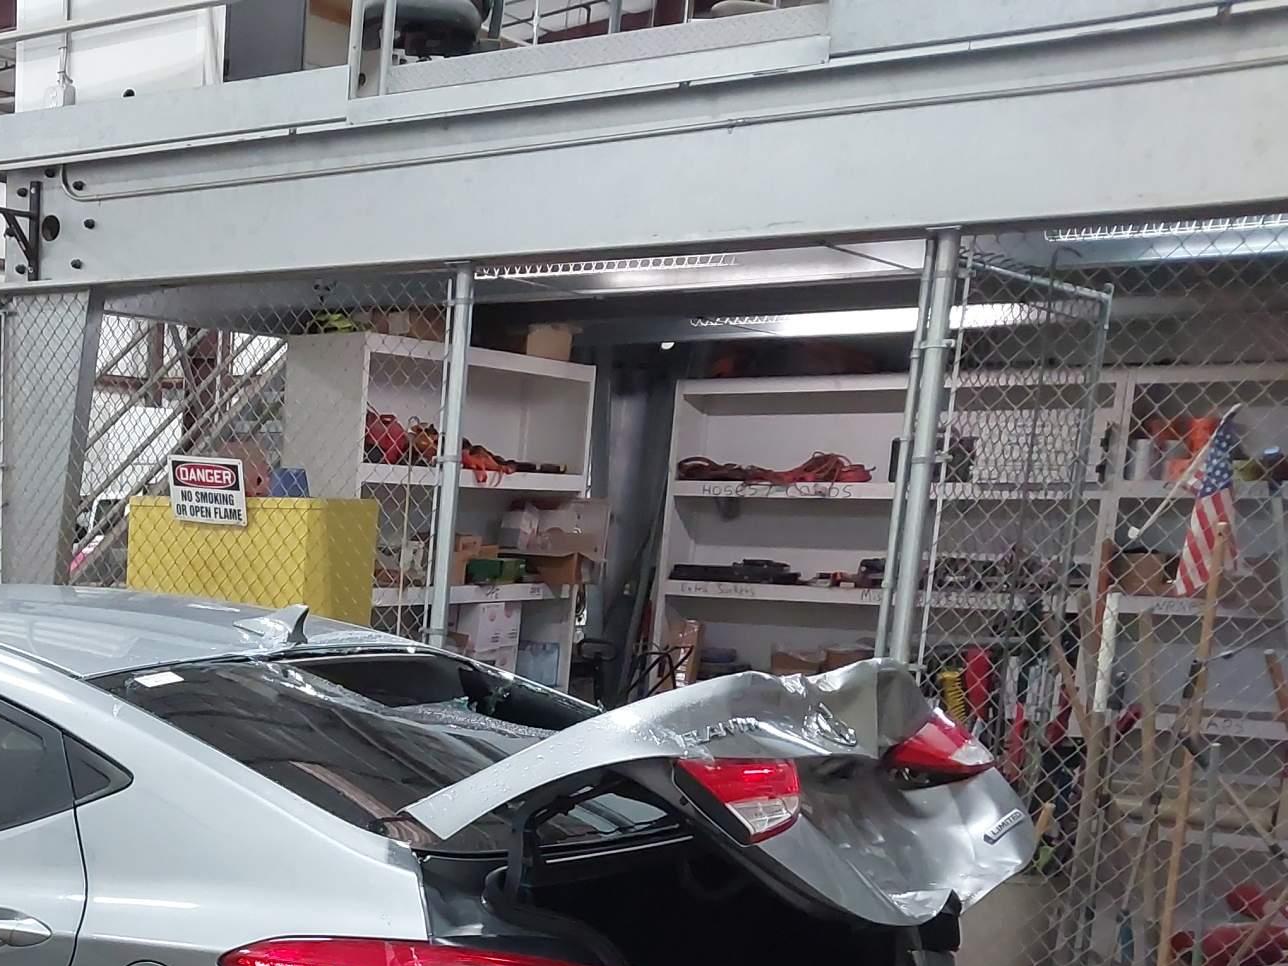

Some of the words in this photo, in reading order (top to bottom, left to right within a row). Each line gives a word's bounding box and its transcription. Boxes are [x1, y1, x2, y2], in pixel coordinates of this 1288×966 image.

[179, 467, 232, 484] DANGER
[181, 490, 193, 502] NO
[195, 491, 234, 506] SMOKING
[176, 504, 187, 516] OR
[189, 505, 212, 518] OPEN
[214, 507, 243, 521] FLAME
[990, 810, 1023, 836] LIMITED
